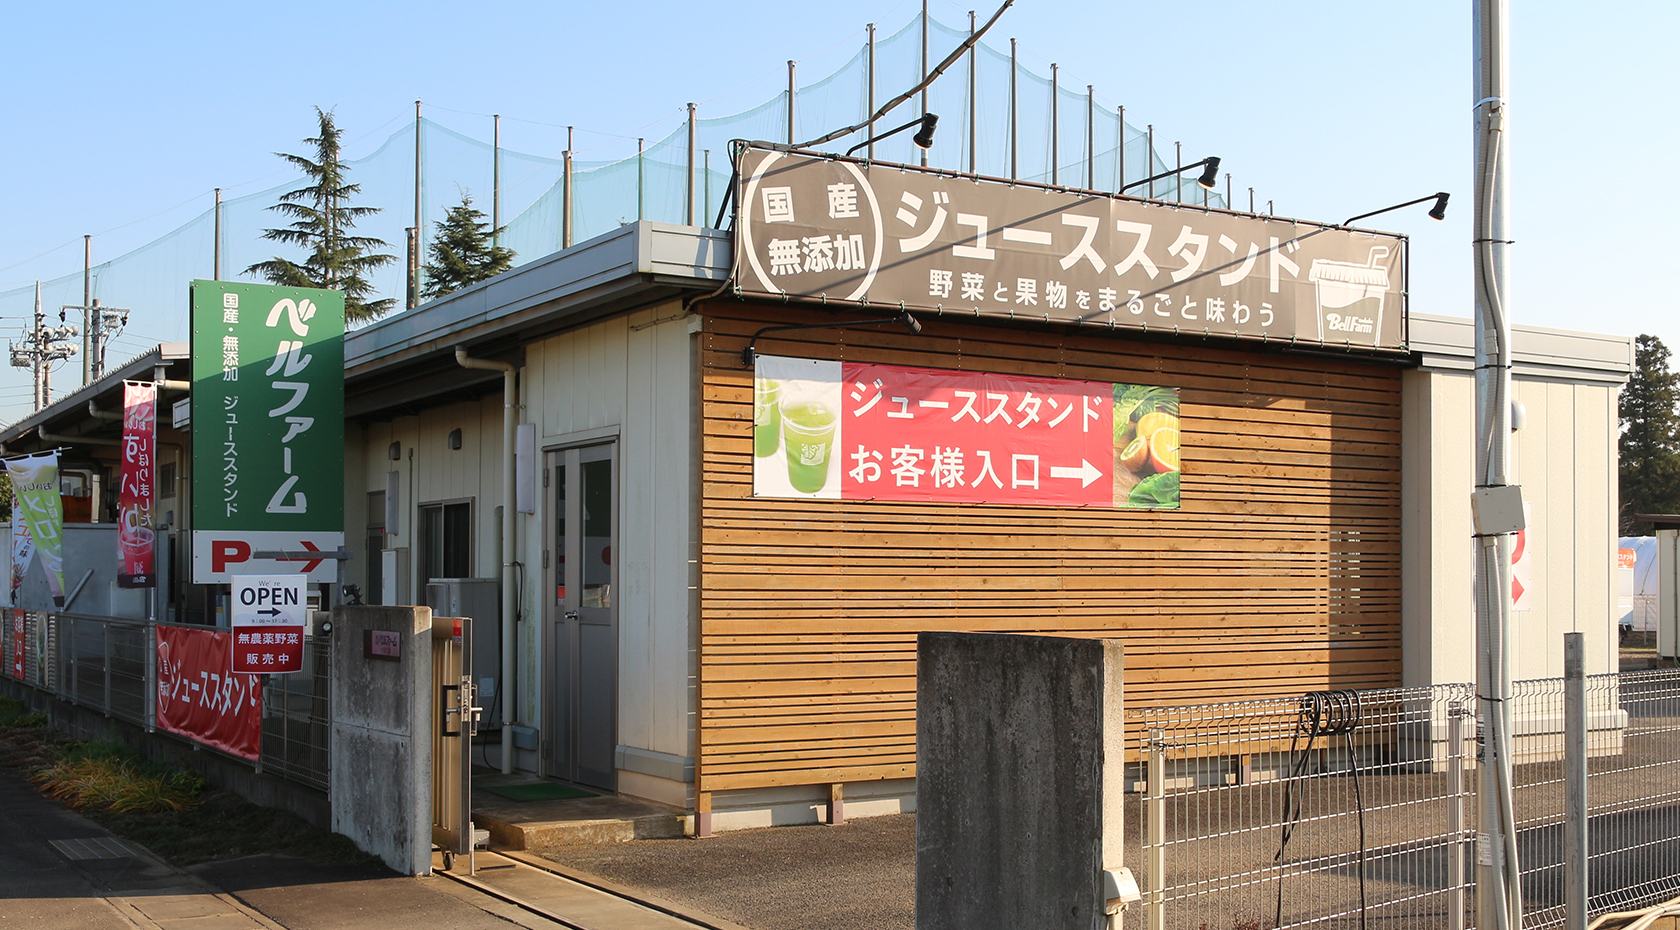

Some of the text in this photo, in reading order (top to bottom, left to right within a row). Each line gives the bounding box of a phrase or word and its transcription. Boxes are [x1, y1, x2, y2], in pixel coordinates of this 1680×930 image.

[761, 183, 860, 224] 国産
[768, 234, 866, 276] 無添加
[896, 190, 1301, 293] ジューススタンド
[929, 269, 1275, 327] 野菜と果物をまるごと味わう
[265, 298, 317, 514] ベルファーム
[849, 378, 1102, 433] ジューススタンド
[223, 395, 239, 517] ジューススタンド
[848, 444, 1039, 490] お客様入口
[212, 540, 252, 573] P
[240, 587, 298, 606] OPEN
[238, 632, 299, 645] 無農薬野菜
[246, 653, 289, 665] 販売中
